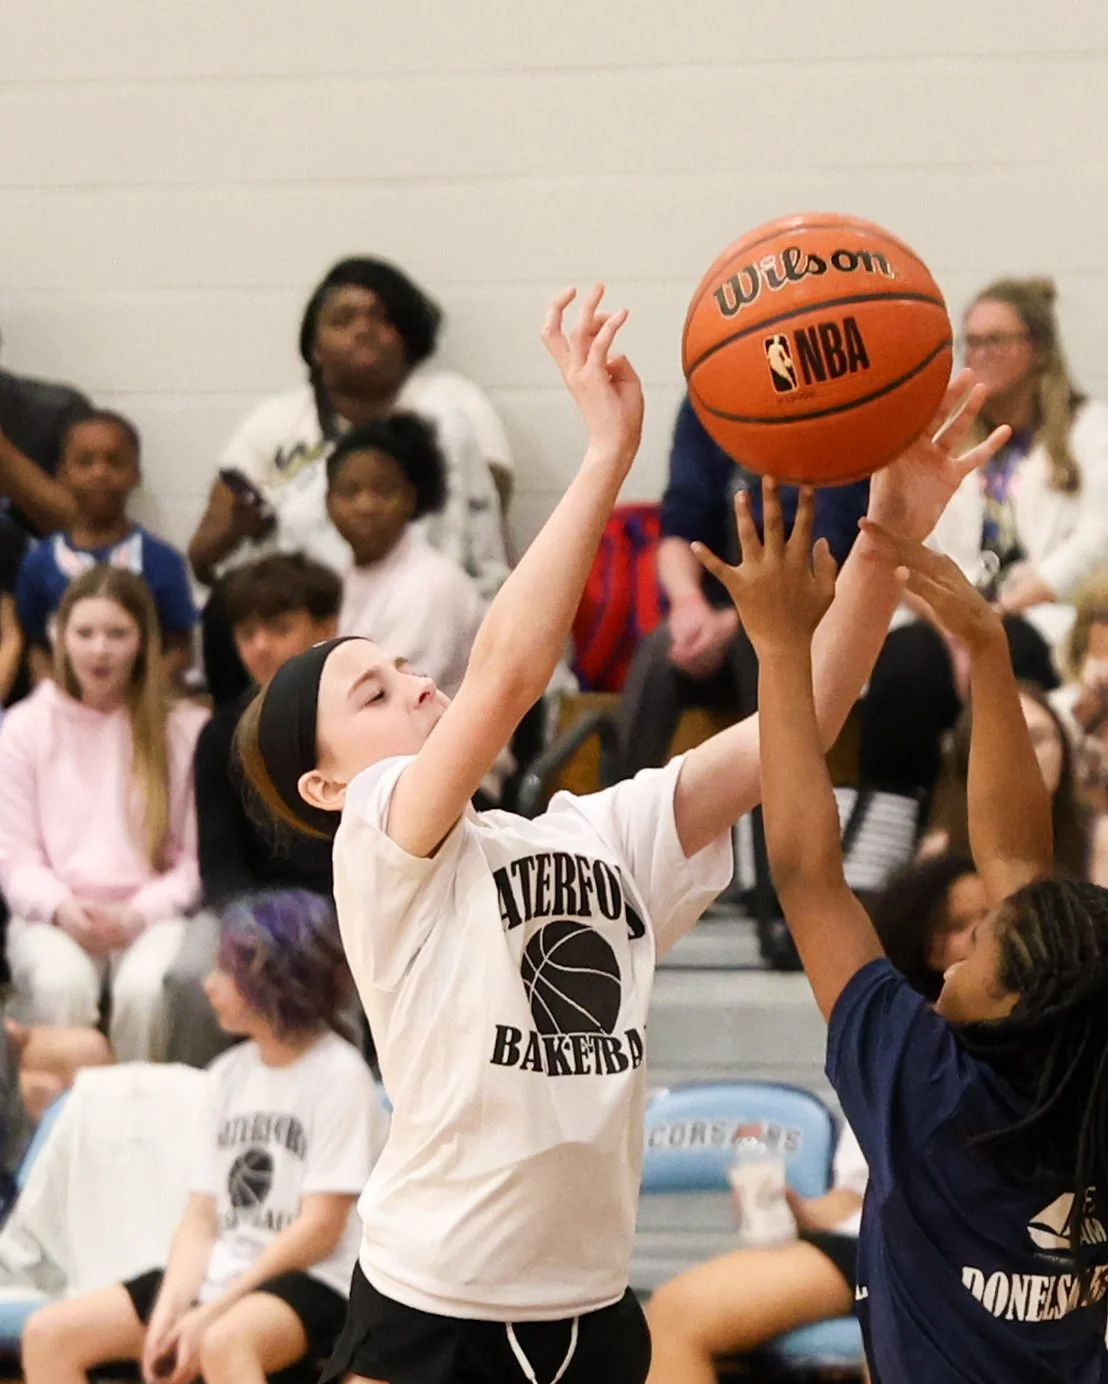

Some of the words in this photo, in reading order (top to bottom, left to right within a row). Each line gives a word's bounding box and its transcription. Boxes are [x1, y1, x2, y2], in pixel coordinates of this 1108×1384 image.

[712, 246, 896, 319] Wilson
[793, 316, 870, 385] NBA
[492, 852, 646, 940] ATERFO
[648, 1121, 800, 1152] CORSRS
